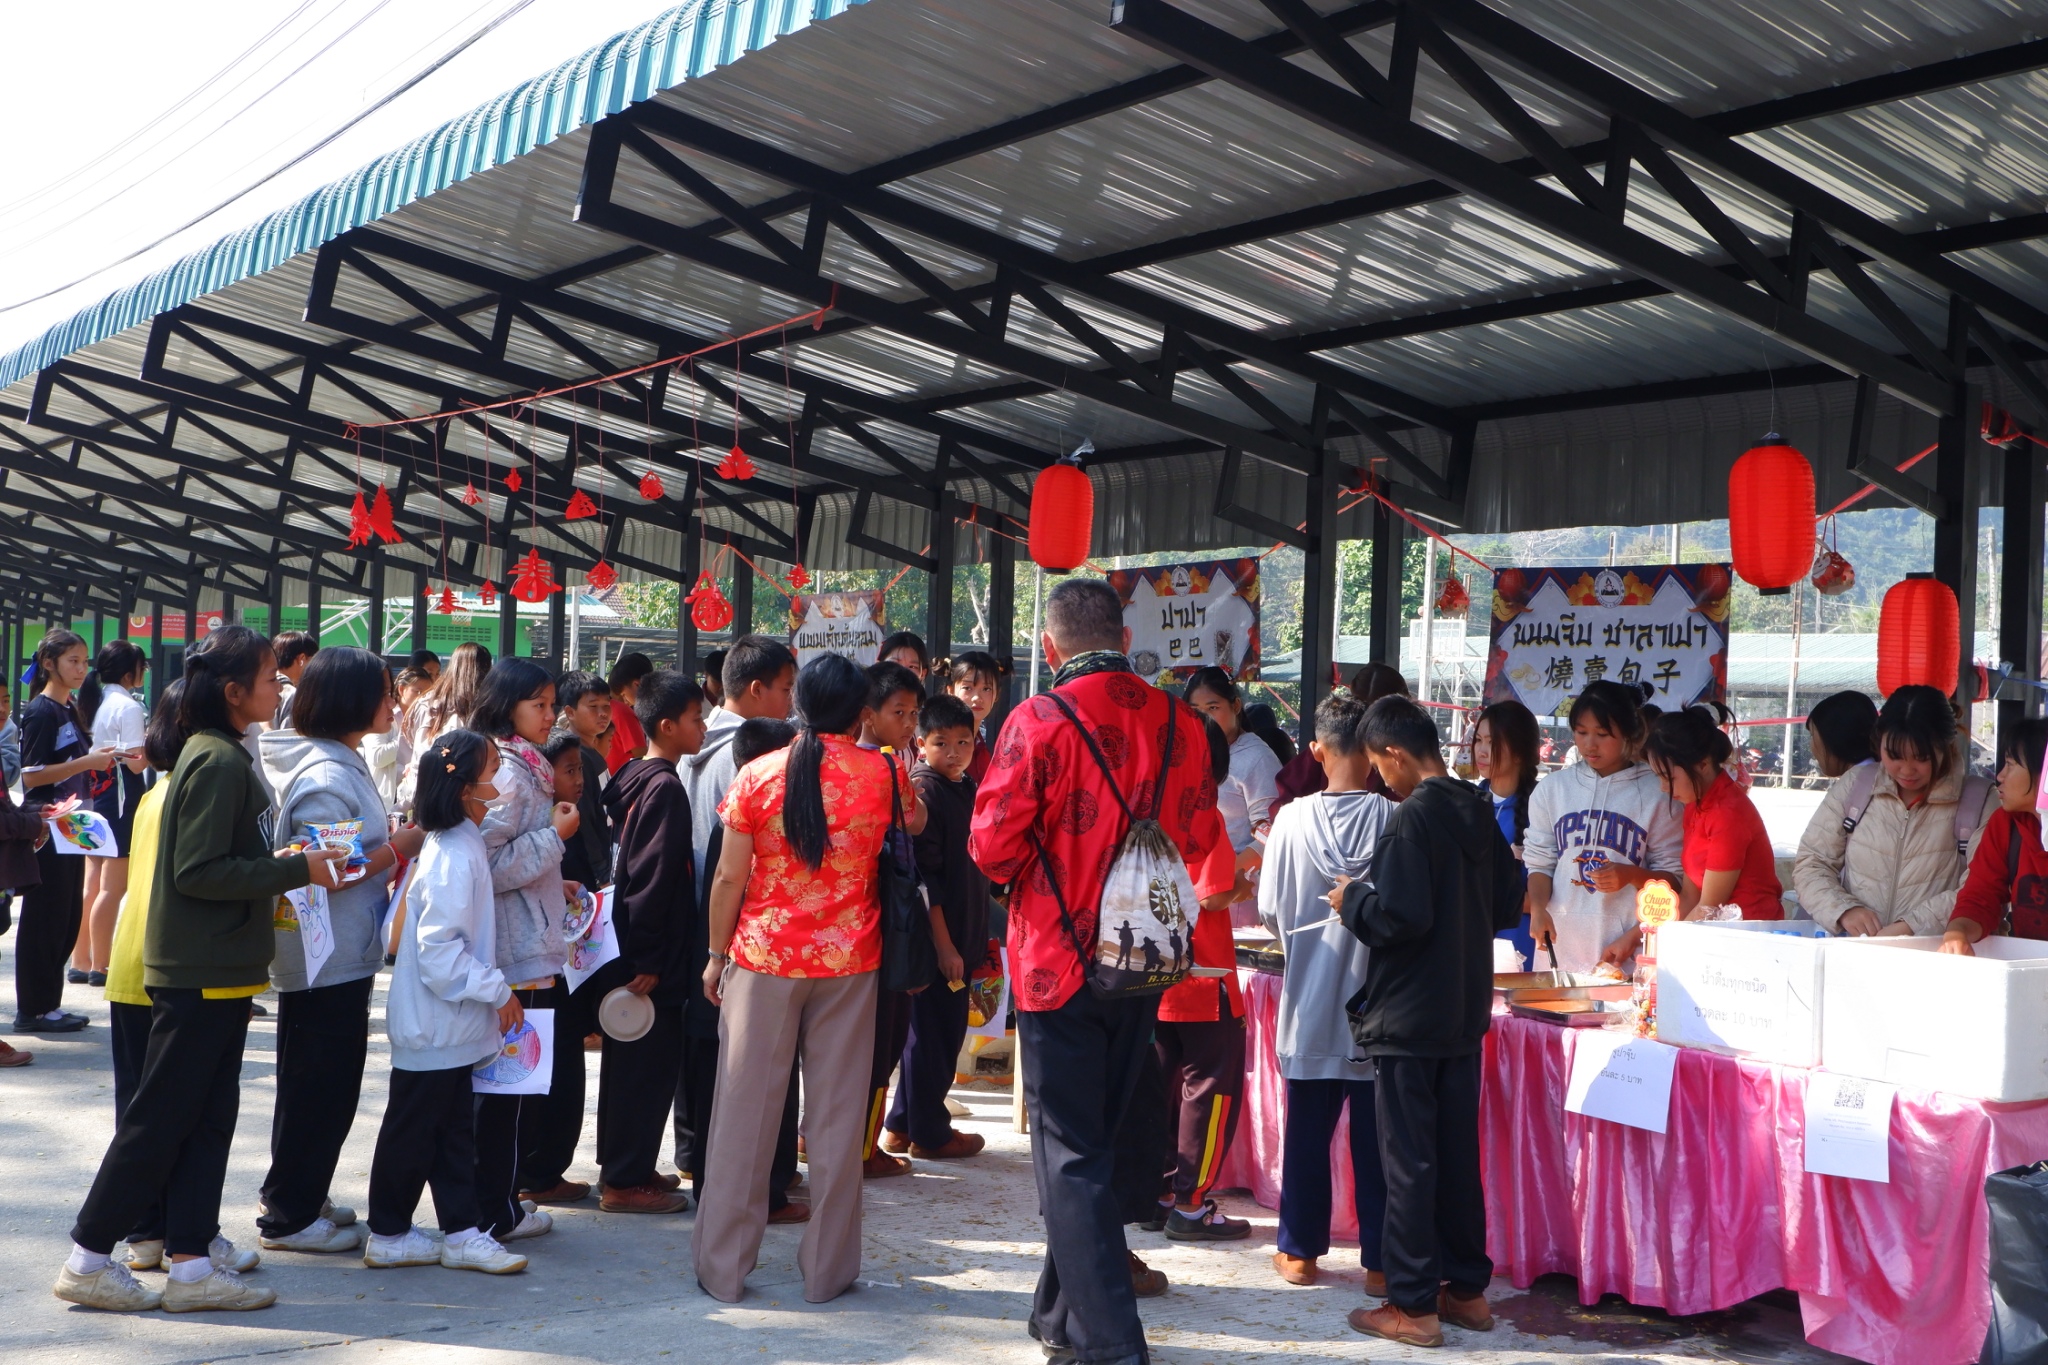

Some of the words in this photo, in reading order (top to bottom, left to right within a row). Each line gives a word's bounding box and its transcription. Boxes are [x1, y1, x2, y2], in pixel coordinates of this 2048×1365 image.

[1161, 600, 1207, 631] ปาปา
[1513, 612, 1592, 649] ขนมจีบ
[1603, 615, 1708, 652] ซาลาเปา
[1554, 810, 1648, 865] UPSTATE
[1643, 905, 1671, 922] Chups
[1644, 893, 1672, 908] Chupa
[1701, 965, 1767, 994] น้ำดื่มทุกชนิด
[1694, 1006, 1728, 1022] ขวดละ
[1733, 1011, 1746, 1024] 10
[1750, 1015, 1772, 1029] บาท
[1620, 1073, 1626, 1082] 5
[1627, 1075, 1643, 1086] บาท
